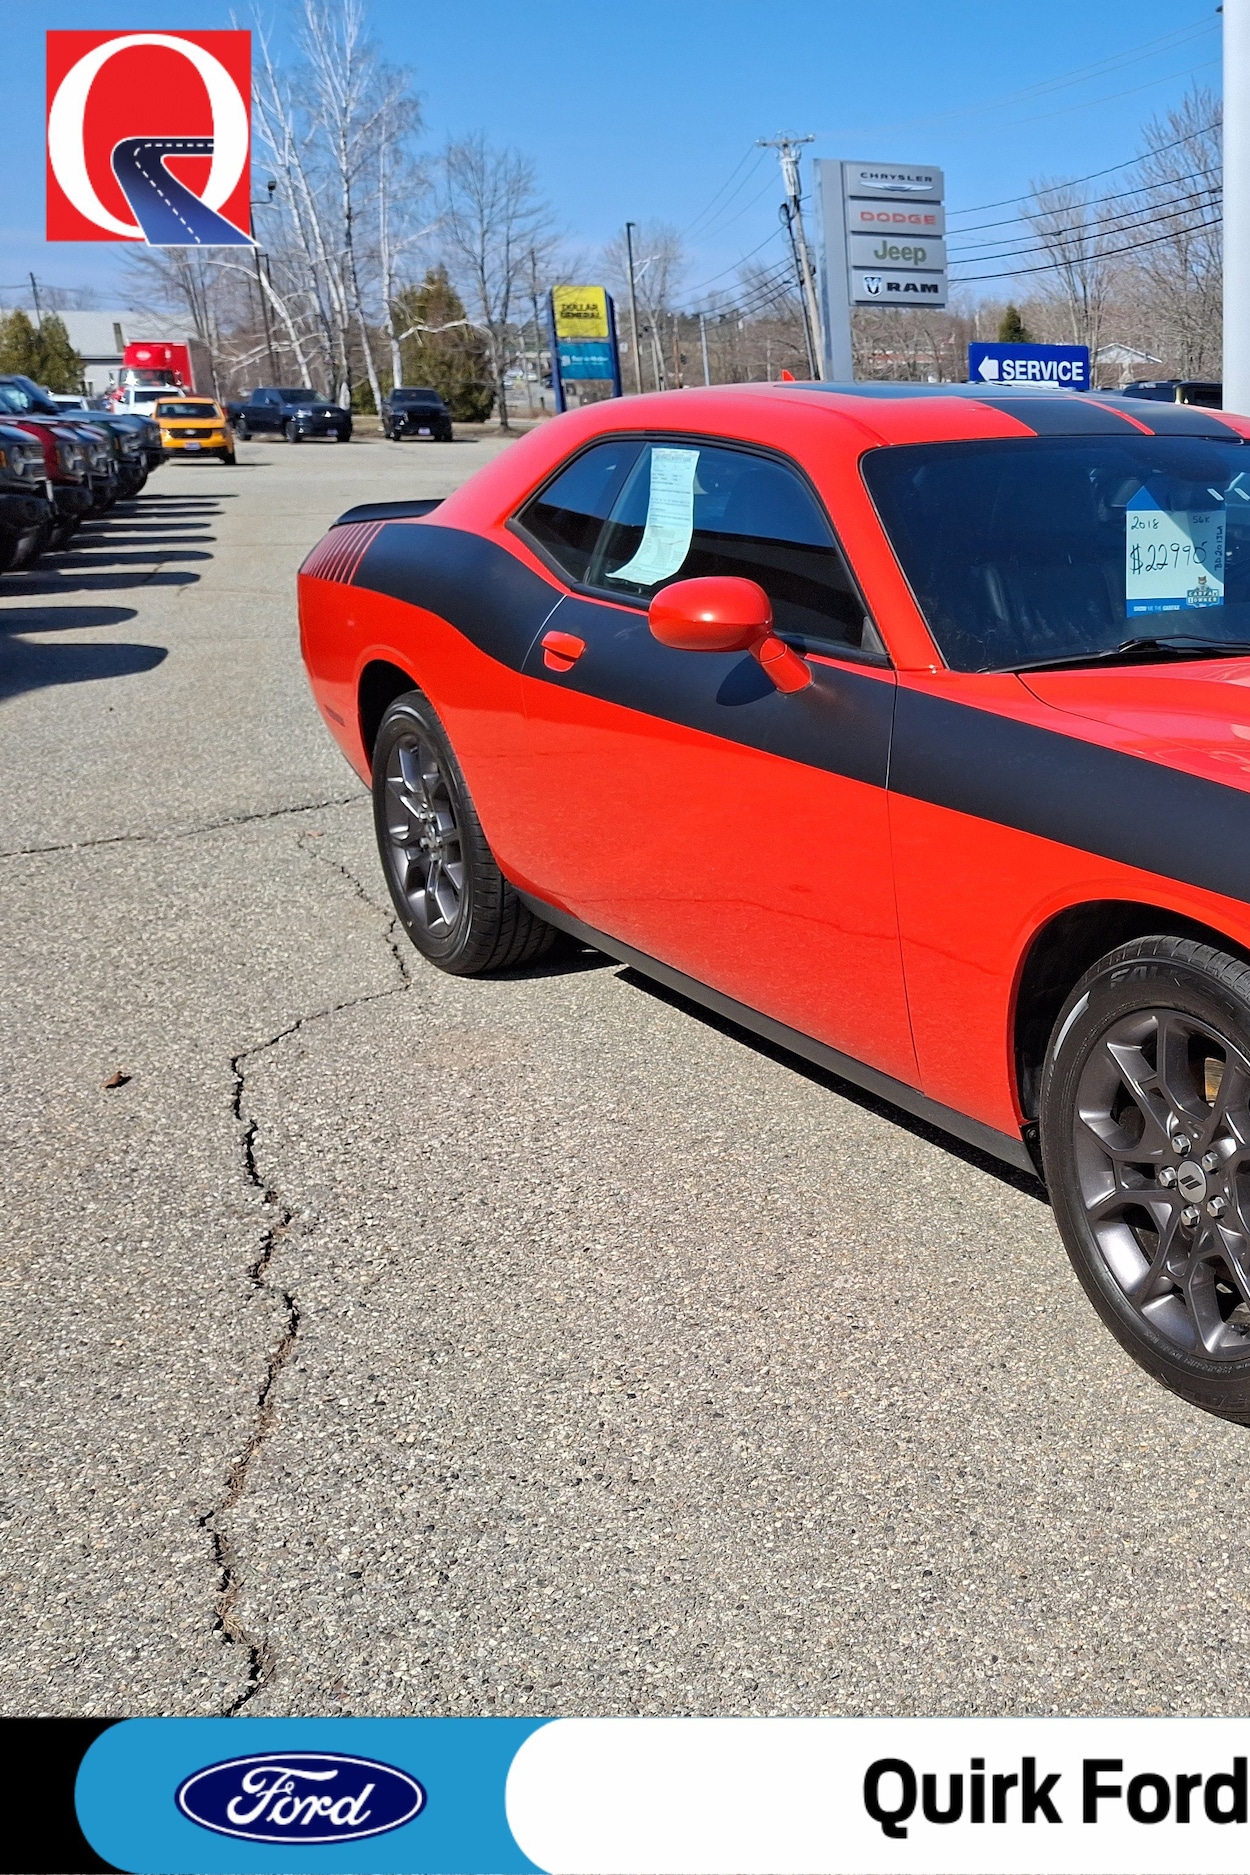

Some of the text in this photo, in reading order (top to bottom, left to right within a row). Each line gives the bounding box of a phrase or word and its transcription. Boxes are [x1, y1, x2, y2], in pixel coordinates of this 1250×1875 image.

[860, 172, 933, 183] CHRYSLER
[860, 211, 937, 225] DODGE
[874, 240, 927, 265] Jeep
[886, 282, 939, 294] RAM
[1002, 359, 1085, 381] SERVICE
[1131, 515, 1160, 530] 2018
